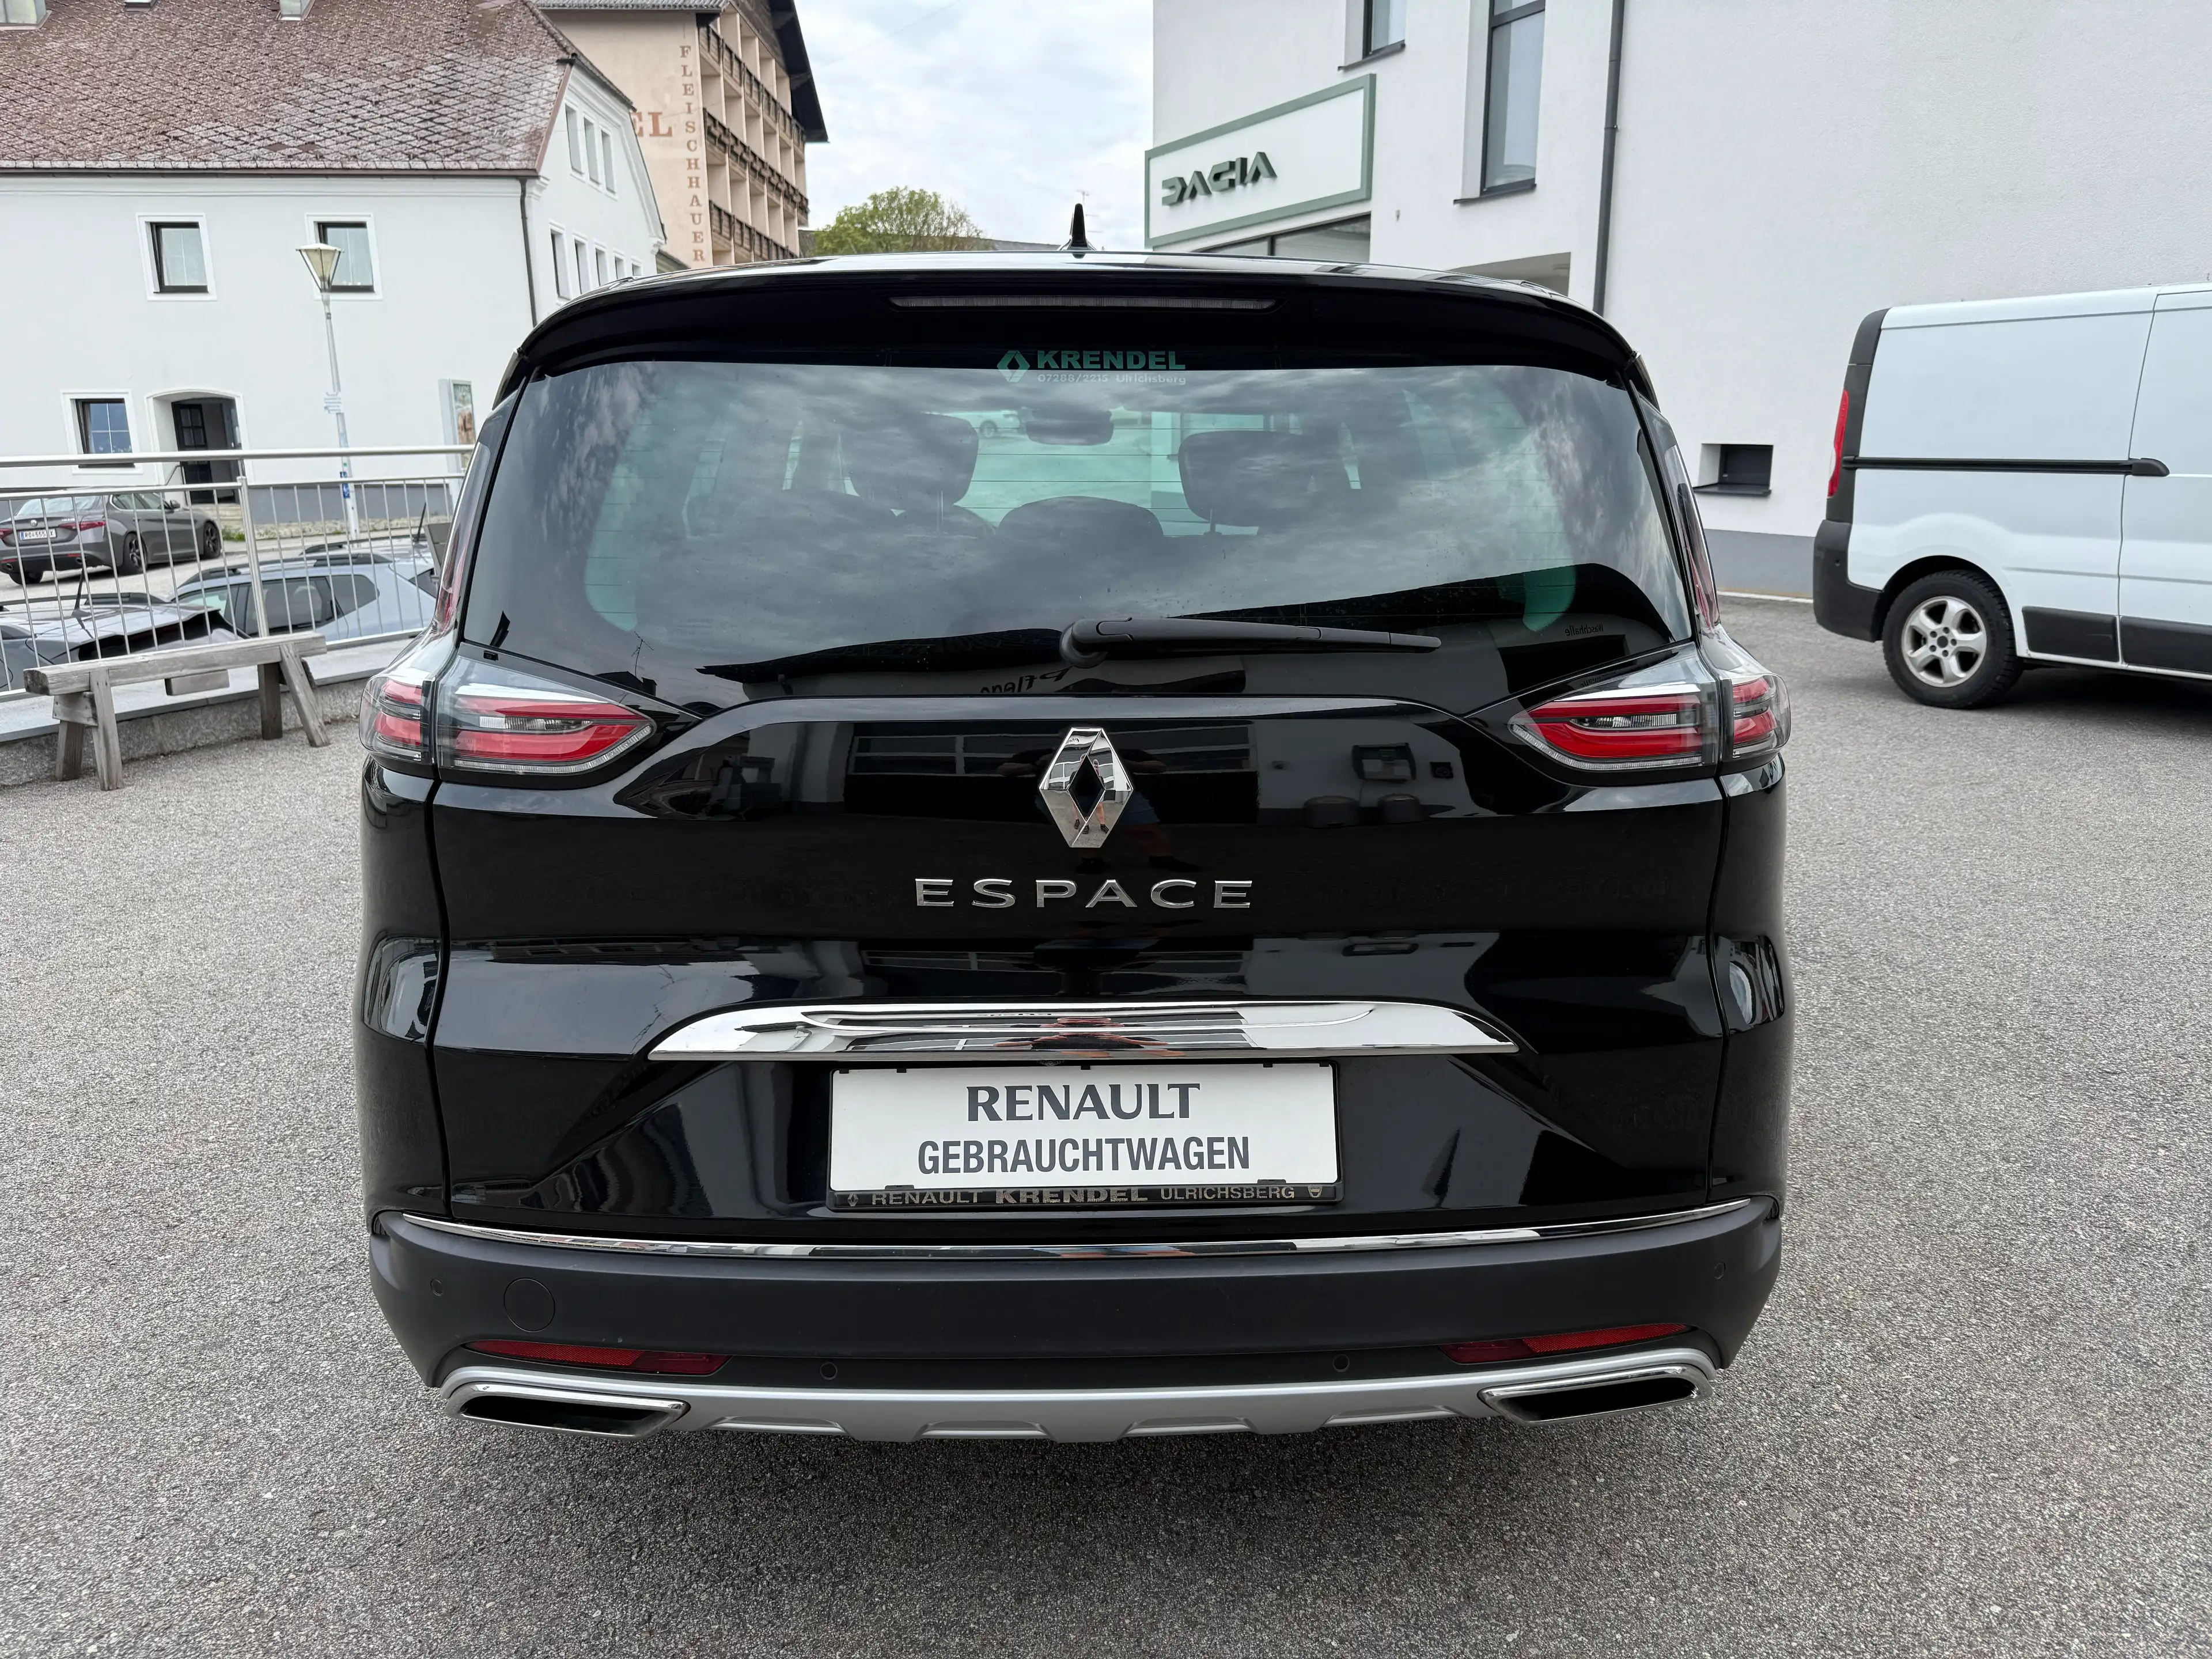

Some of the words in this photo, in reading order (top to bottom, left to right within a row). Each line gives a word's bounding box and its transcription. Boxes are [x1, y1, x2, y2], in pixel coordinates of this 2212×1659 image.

[679, 46, 706, 262] FLEISCHHAUER
[1161, 151, 1277, 206] DACIA
[1037, 350, 1186, 369] KRENDEL
[1037, 373, 1108, 383] 07288/2215
[1116, 373, 1187, 385] Ulrichsberg
[915, 878, 1253, 909] ESPACE
[966, 1084, 1200, 1122] RENAULT
[918, 1136, 1250, 1175] GEBRAUCHTWAGEN
[871, 1190, 983, 1206] RENAULT
[995, 1187, 1148, 1205] KRENDEL
[1160, 1185, 1296, 1200] ULRICHSBERG
